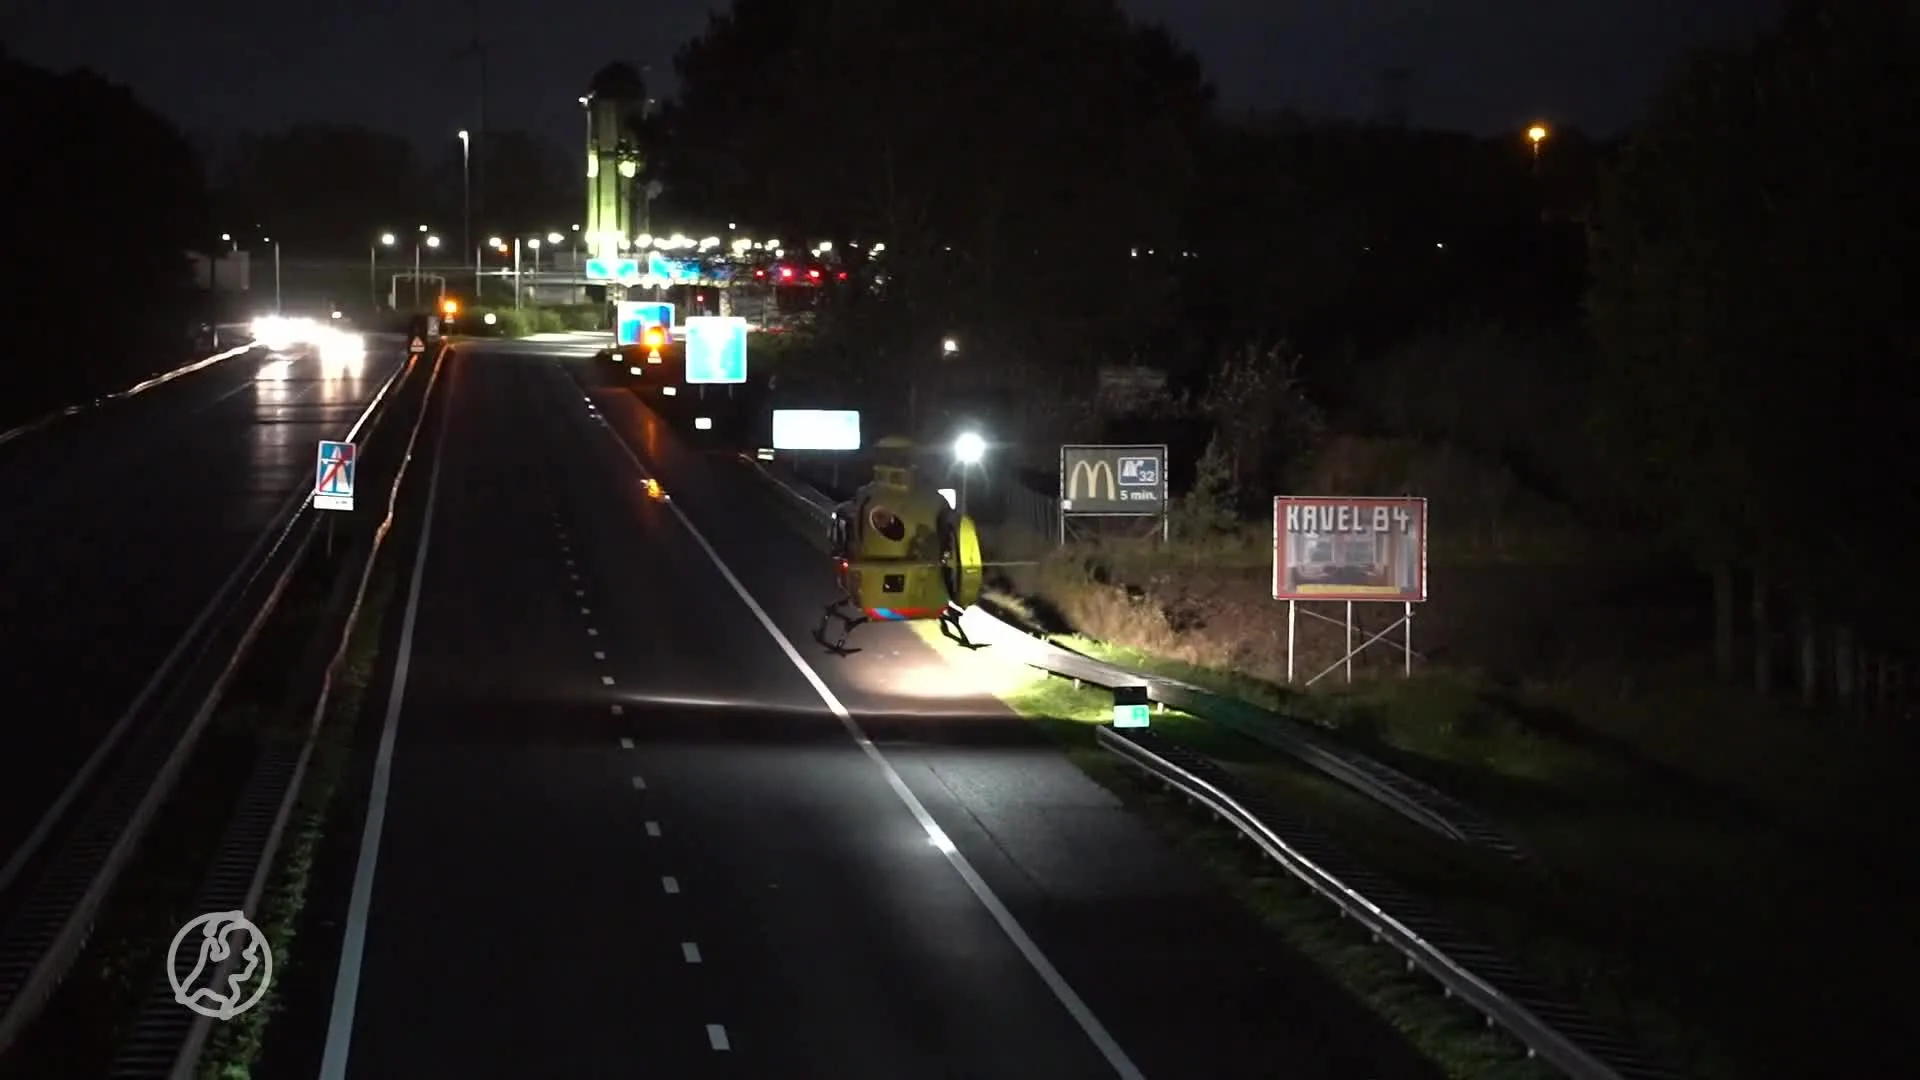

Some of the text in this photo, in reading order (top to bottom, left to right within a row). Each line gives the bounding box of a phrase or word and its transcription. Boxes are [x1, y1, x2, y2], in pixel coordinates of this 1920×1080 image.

[1139, 471, 1155, 482] 32
[1120, 489, 1157, 500] 5 min.
[1286, 504, 1410, 532] KAVEL 84
